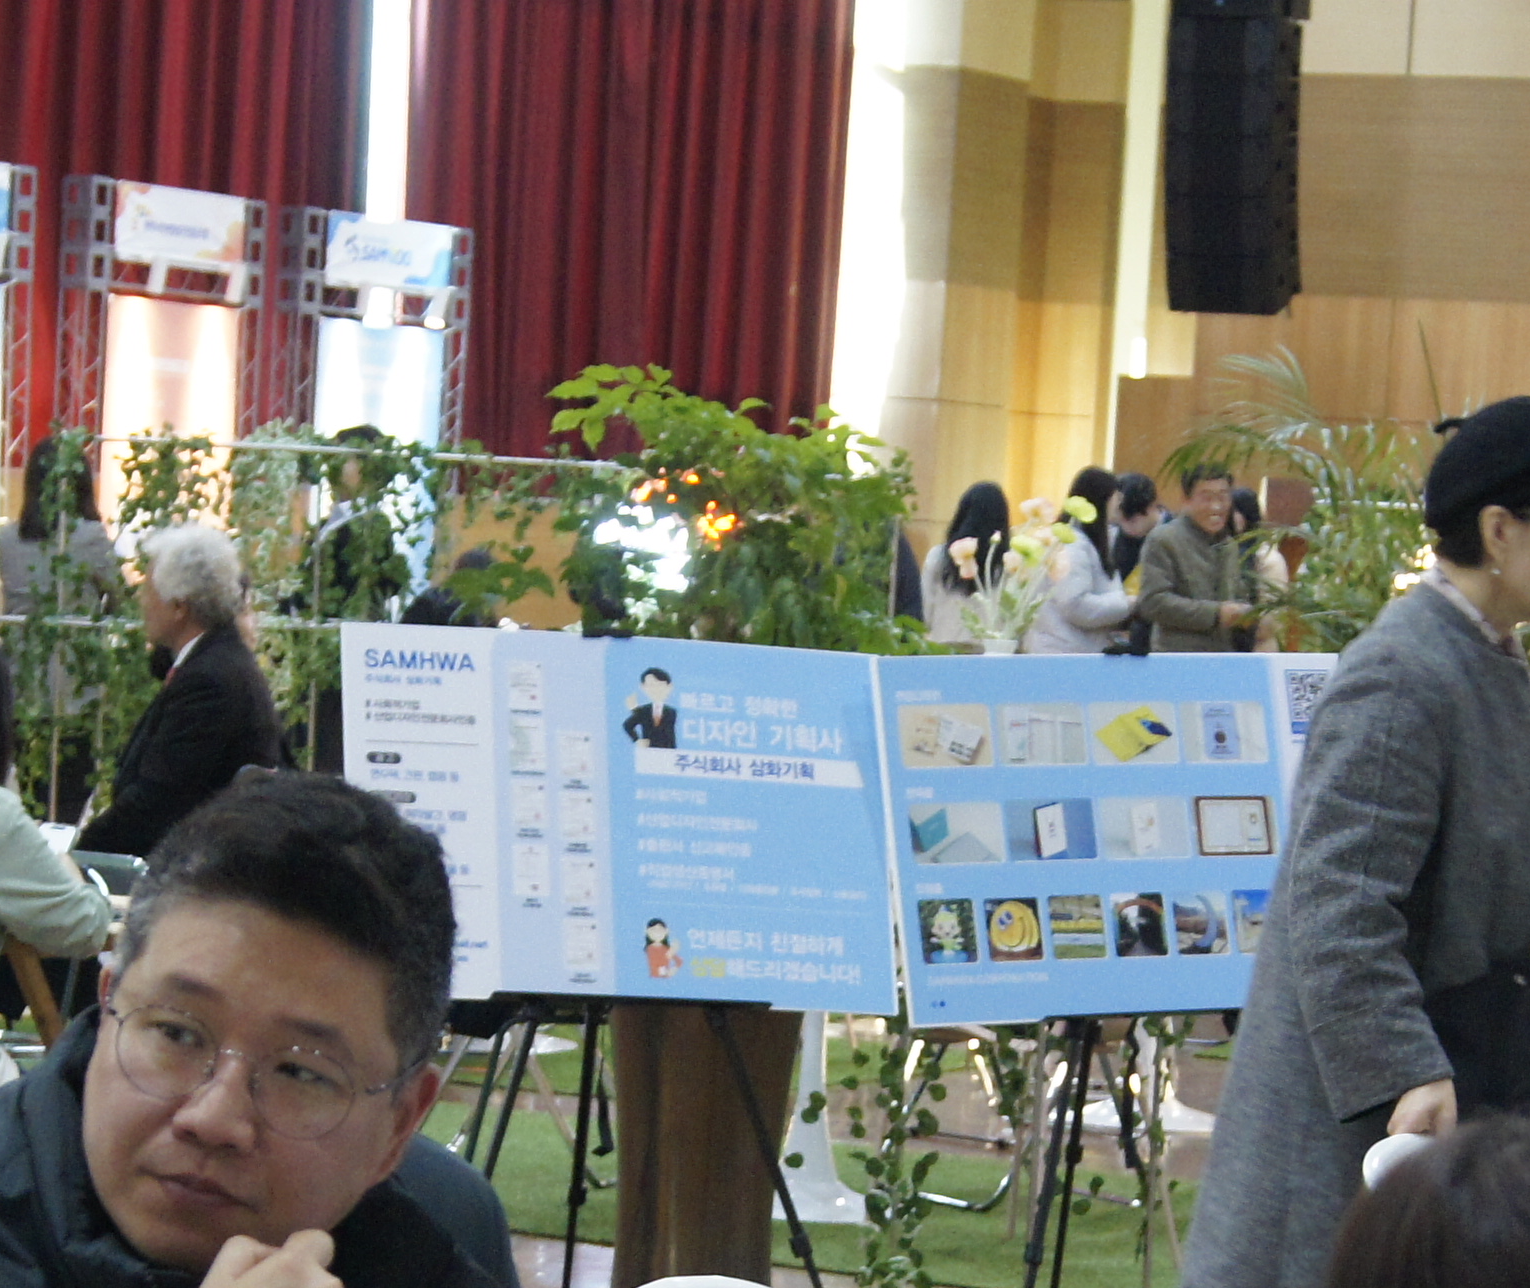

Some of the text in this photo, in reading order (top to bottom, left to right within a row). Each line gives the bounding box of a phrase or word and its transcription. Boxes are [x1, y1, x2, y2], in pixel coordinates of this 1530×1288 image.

[364, 648, 475, 672] SAMHWA
[680, 692, 797, 719] 빠르고 정확한
[682, 716, 842, 755] 디자인 기획사
[674, 752, 815, 780] 주식회사 삼화기획
[687, 928, 845, 957] 언제든지 친절하게
